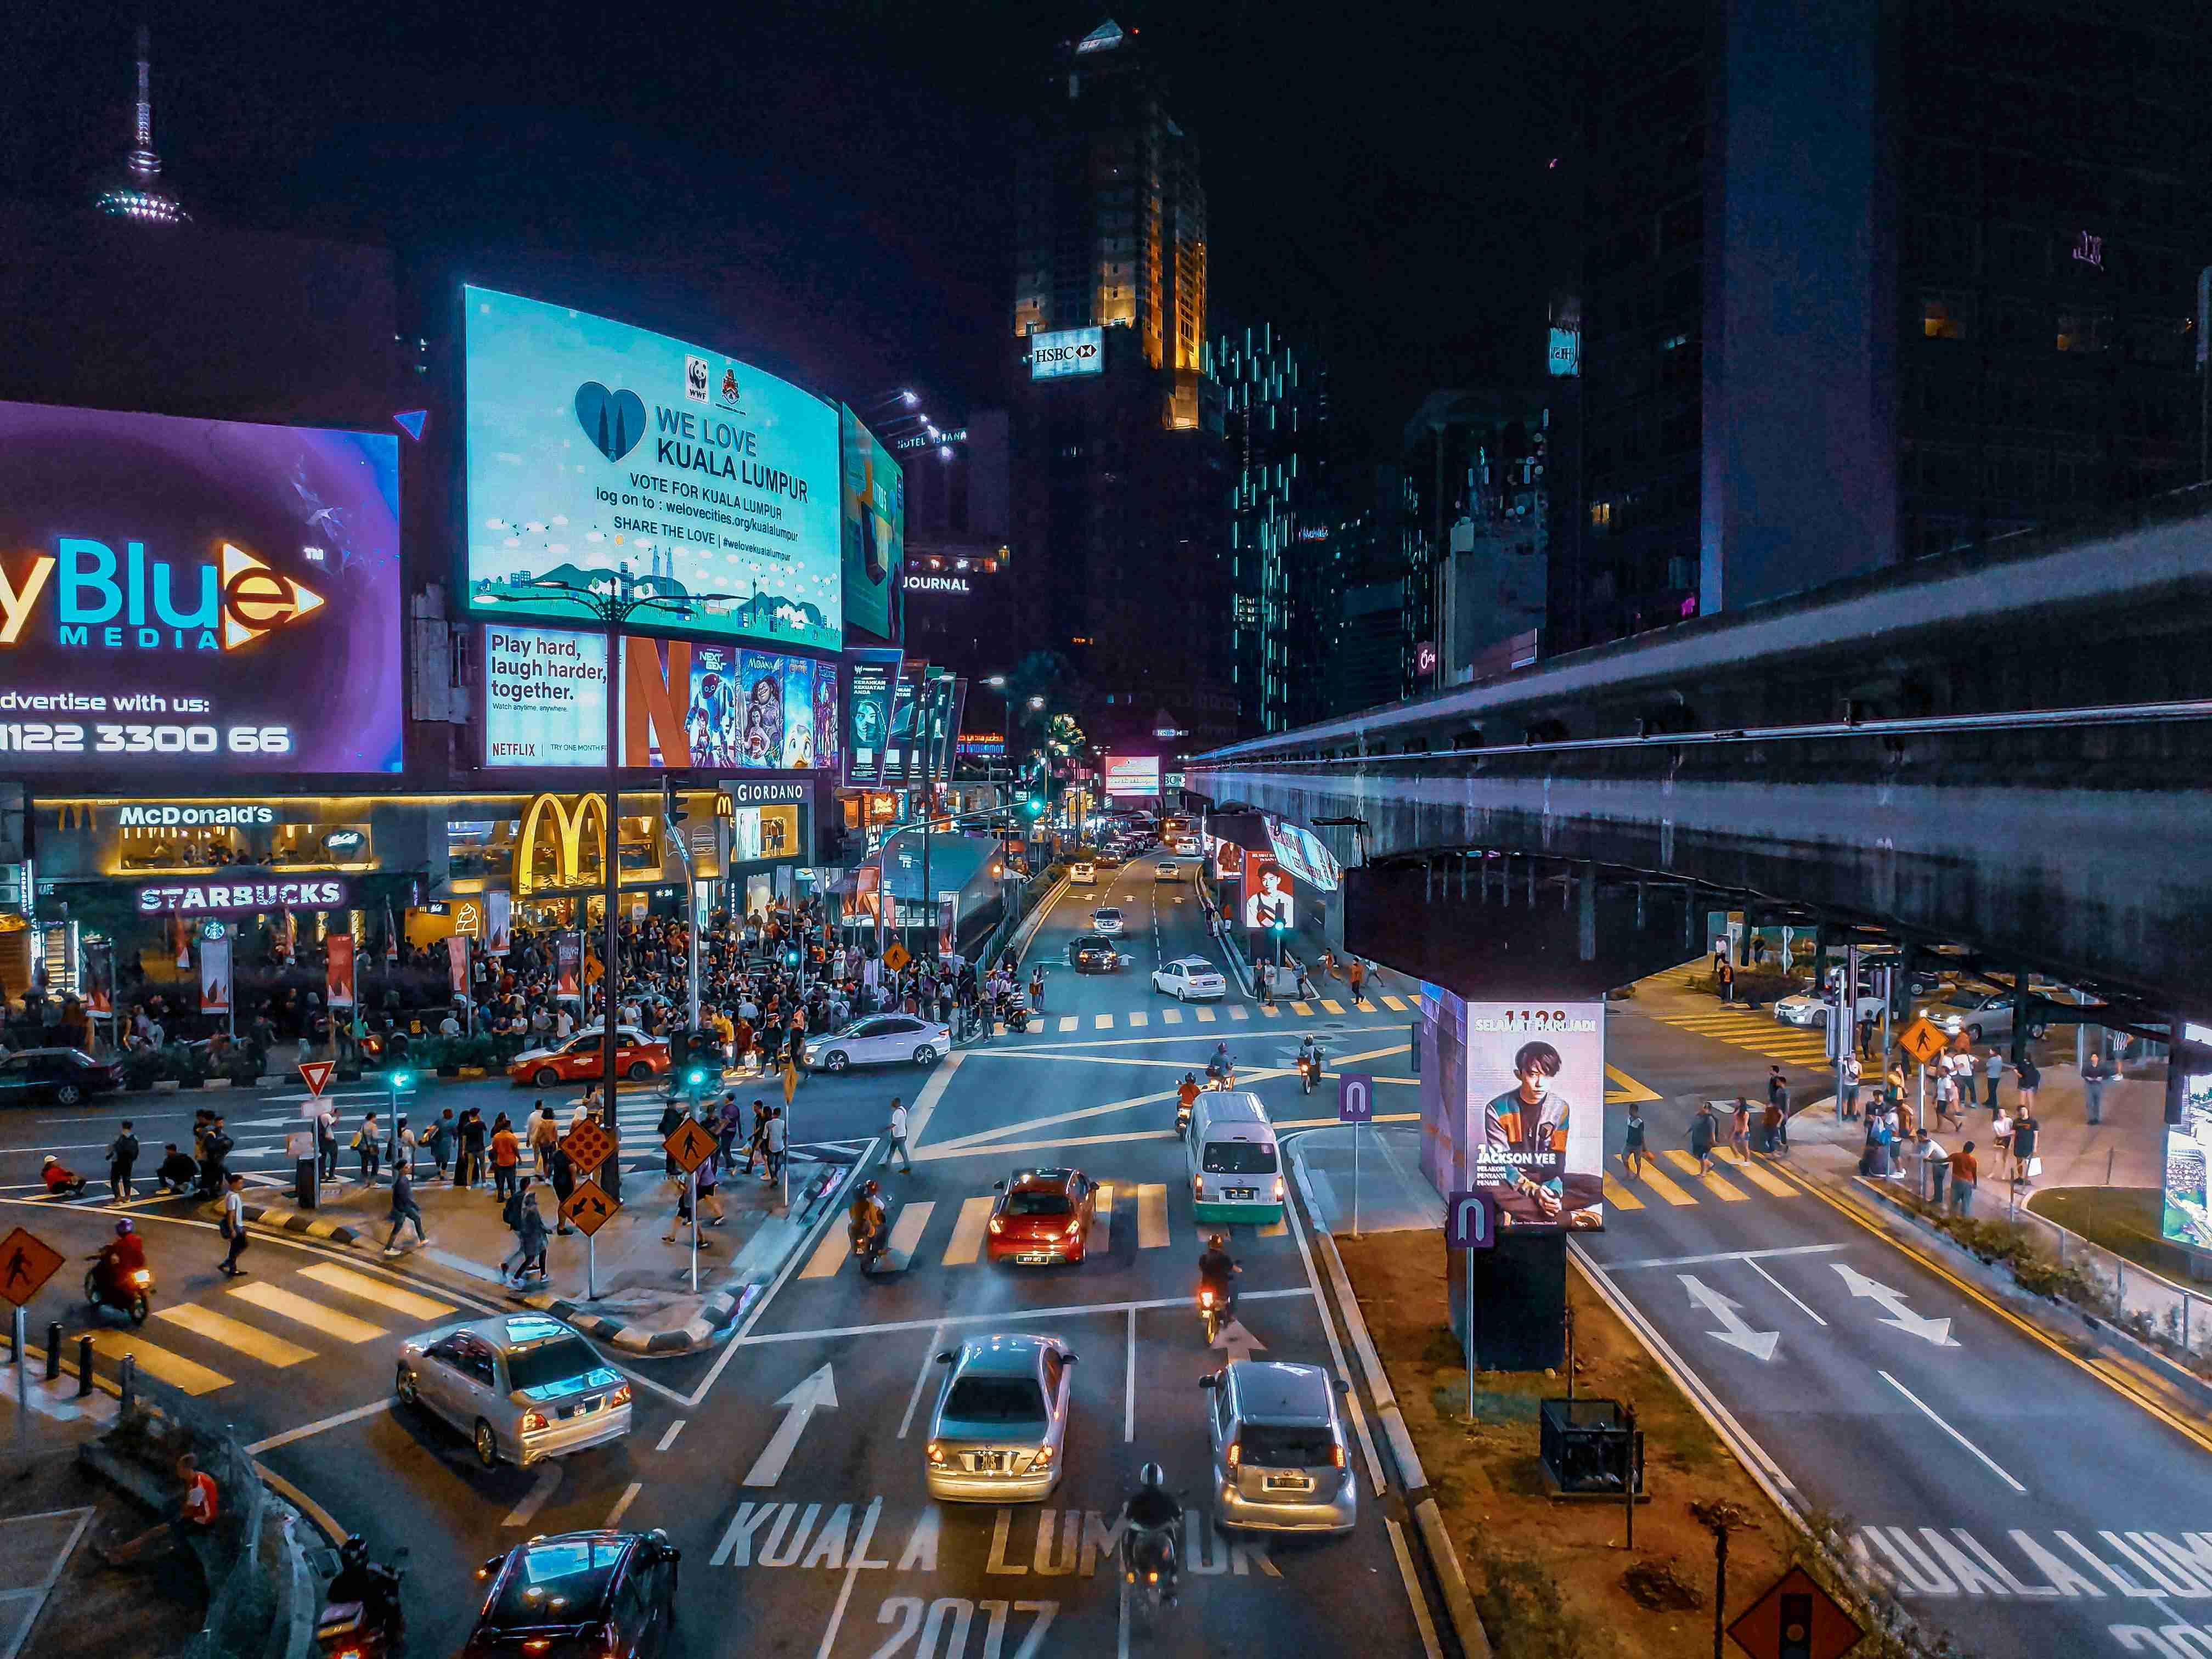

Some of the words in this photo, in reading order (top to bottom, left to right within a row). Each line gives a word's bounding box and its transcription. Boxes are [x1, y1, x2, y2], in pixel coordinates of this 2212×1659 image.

[1035, 346, 1074, 363] HSBC
[689, 388, 707, 400] WWF
[656, 405, 696, 439] WE
[703, 419, 757, 457] LOVE
[658, 437, 737, 482] KUALA
[742, 460, 808, 504] LUMPUR
[630, 472, 668, 493] VOTE
[672, 481, 698, 500] FOR
[702, 487, 742, 510] KUALA
[743, 499, 782, 521] LUMPUR
[596, 486, 618, 506] log
[622, 493, 639, 507] on
[642, 495, 655, 510] to
[666, 501, 798, 543] welovecities.org/kualalumpur
[614, 516, 658, 534] SHARE
[662, 524, 684, 539] THE
[688, 529, 715, 545] LOVE
[723, 537, 791, 562] #welovekualalumpur
[903, 576, 970, 591] JOURNAL
[60, 625, 219, 650] MEDIA
[492, 634, 532, 657] Play
[537, 636, 581, 661] hard,
[699, 651, 724, 663] NEXT
[706, 661, 727, 671] GEN
[748, 658, 775, 670] MOANA
[492, 657, 543, 680] laugh
[548, 660, 607, 684] harder,
[491, 680, 574, 702] together.
[113, 695, 166, 712] with
[173, 698, 210, 712] us:
[513, 703, 539, 712] anytime,
[96, 725, 217, 752] 3300
[228, 727, 290, 752] 66
[492, 743, 536, 757] NETFLIX
[737, 783, 803, 802] GIORDANO
[119, 805, 273, 825] McDonald's
[141, 882, 340, 911] STARBUCKS
[1476, 1153, 1533, 1164] JACKSON
[1534, 1153, 1556, 1165] YEE
[709, 1497, 941, 1572] KUALA
[987, 1508, 1284, 1578] LUMUR
